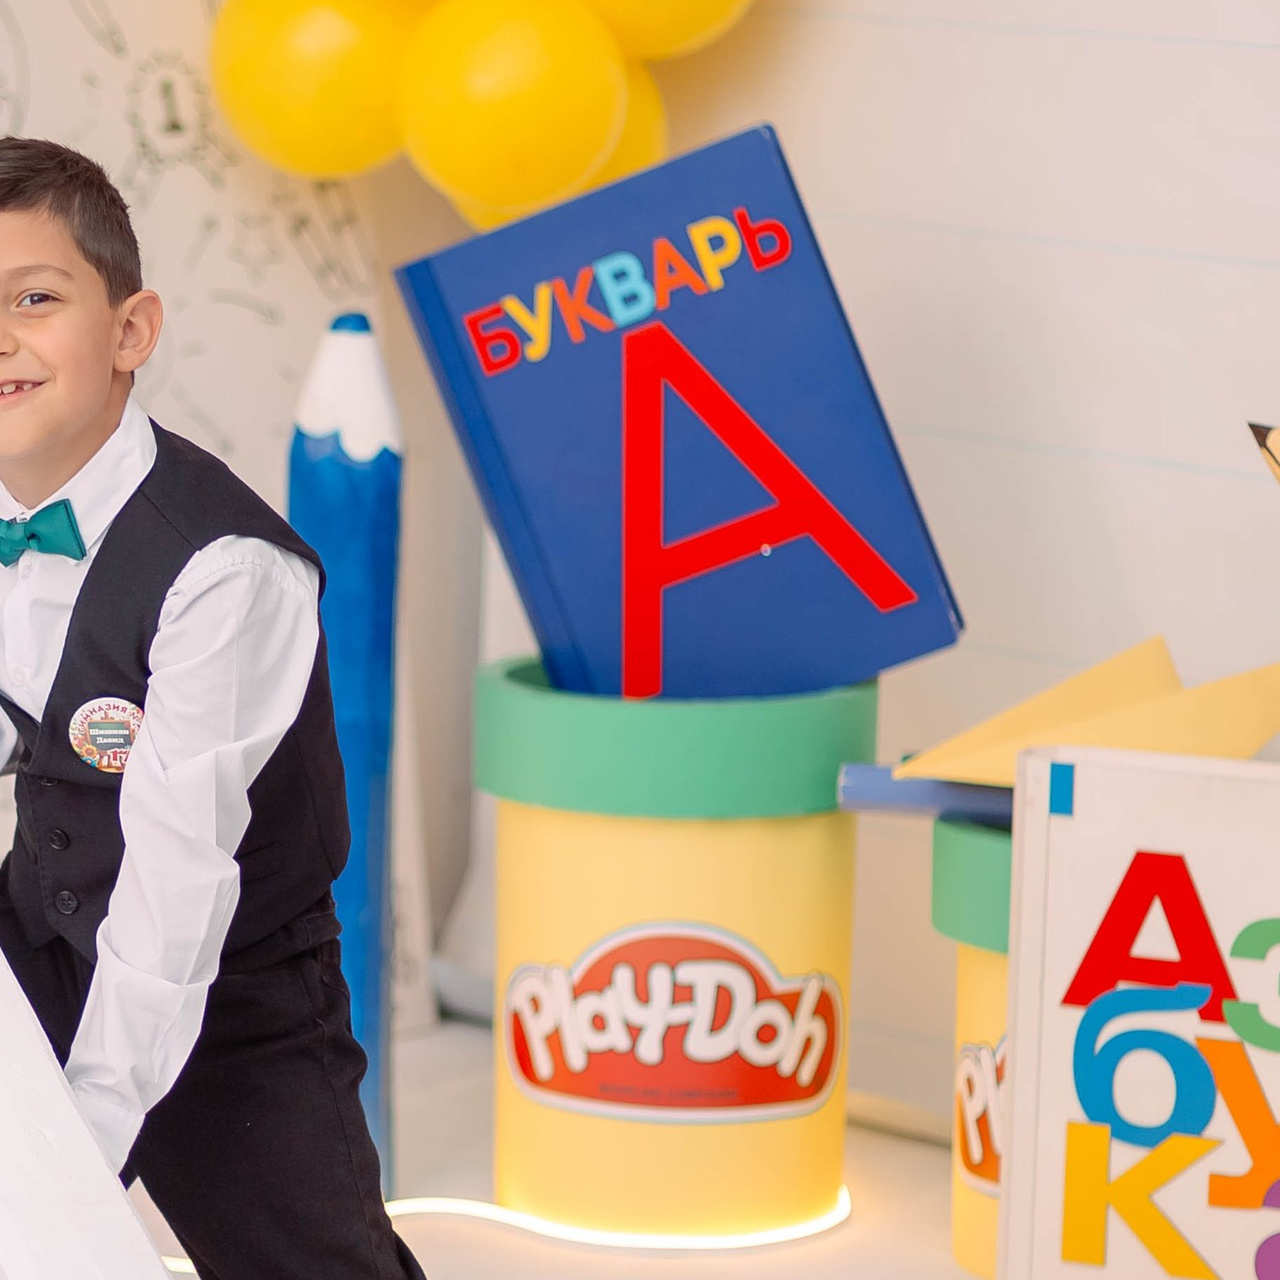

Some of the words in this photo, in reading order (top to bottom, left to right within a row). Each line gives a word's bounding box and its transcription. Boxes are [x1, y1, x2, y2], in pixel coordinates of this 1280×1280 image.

[463, 207, 792, 378] БУКВАРЬ
[622, 320, 919, 701] А
[511, 959, 828, 1087] Play-Doh
[1060, 850, 1239, 1025] А
